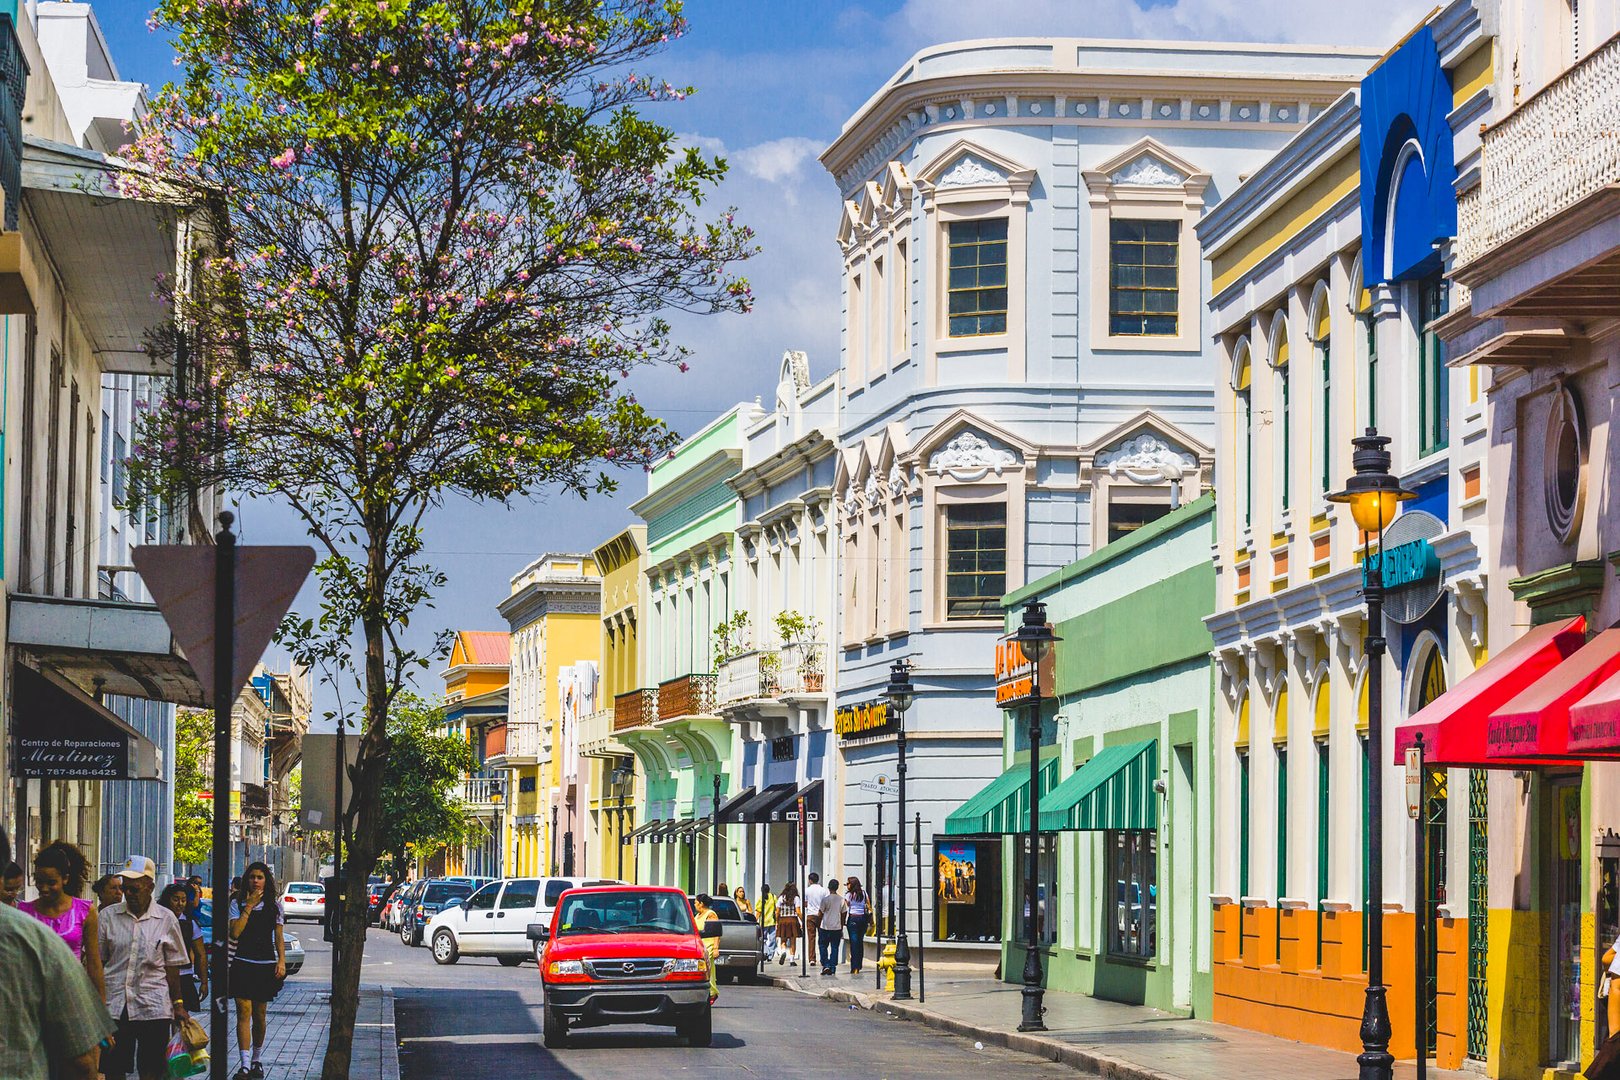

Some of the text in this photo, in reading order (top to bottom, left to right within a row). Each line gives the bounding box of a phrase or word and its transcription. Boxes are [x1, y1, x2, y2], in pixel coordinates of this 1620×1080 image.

[21, 739, 121, 749] Centro de Reparaciones
[24, 768, 117, 776] Tel. 787-848-6425
